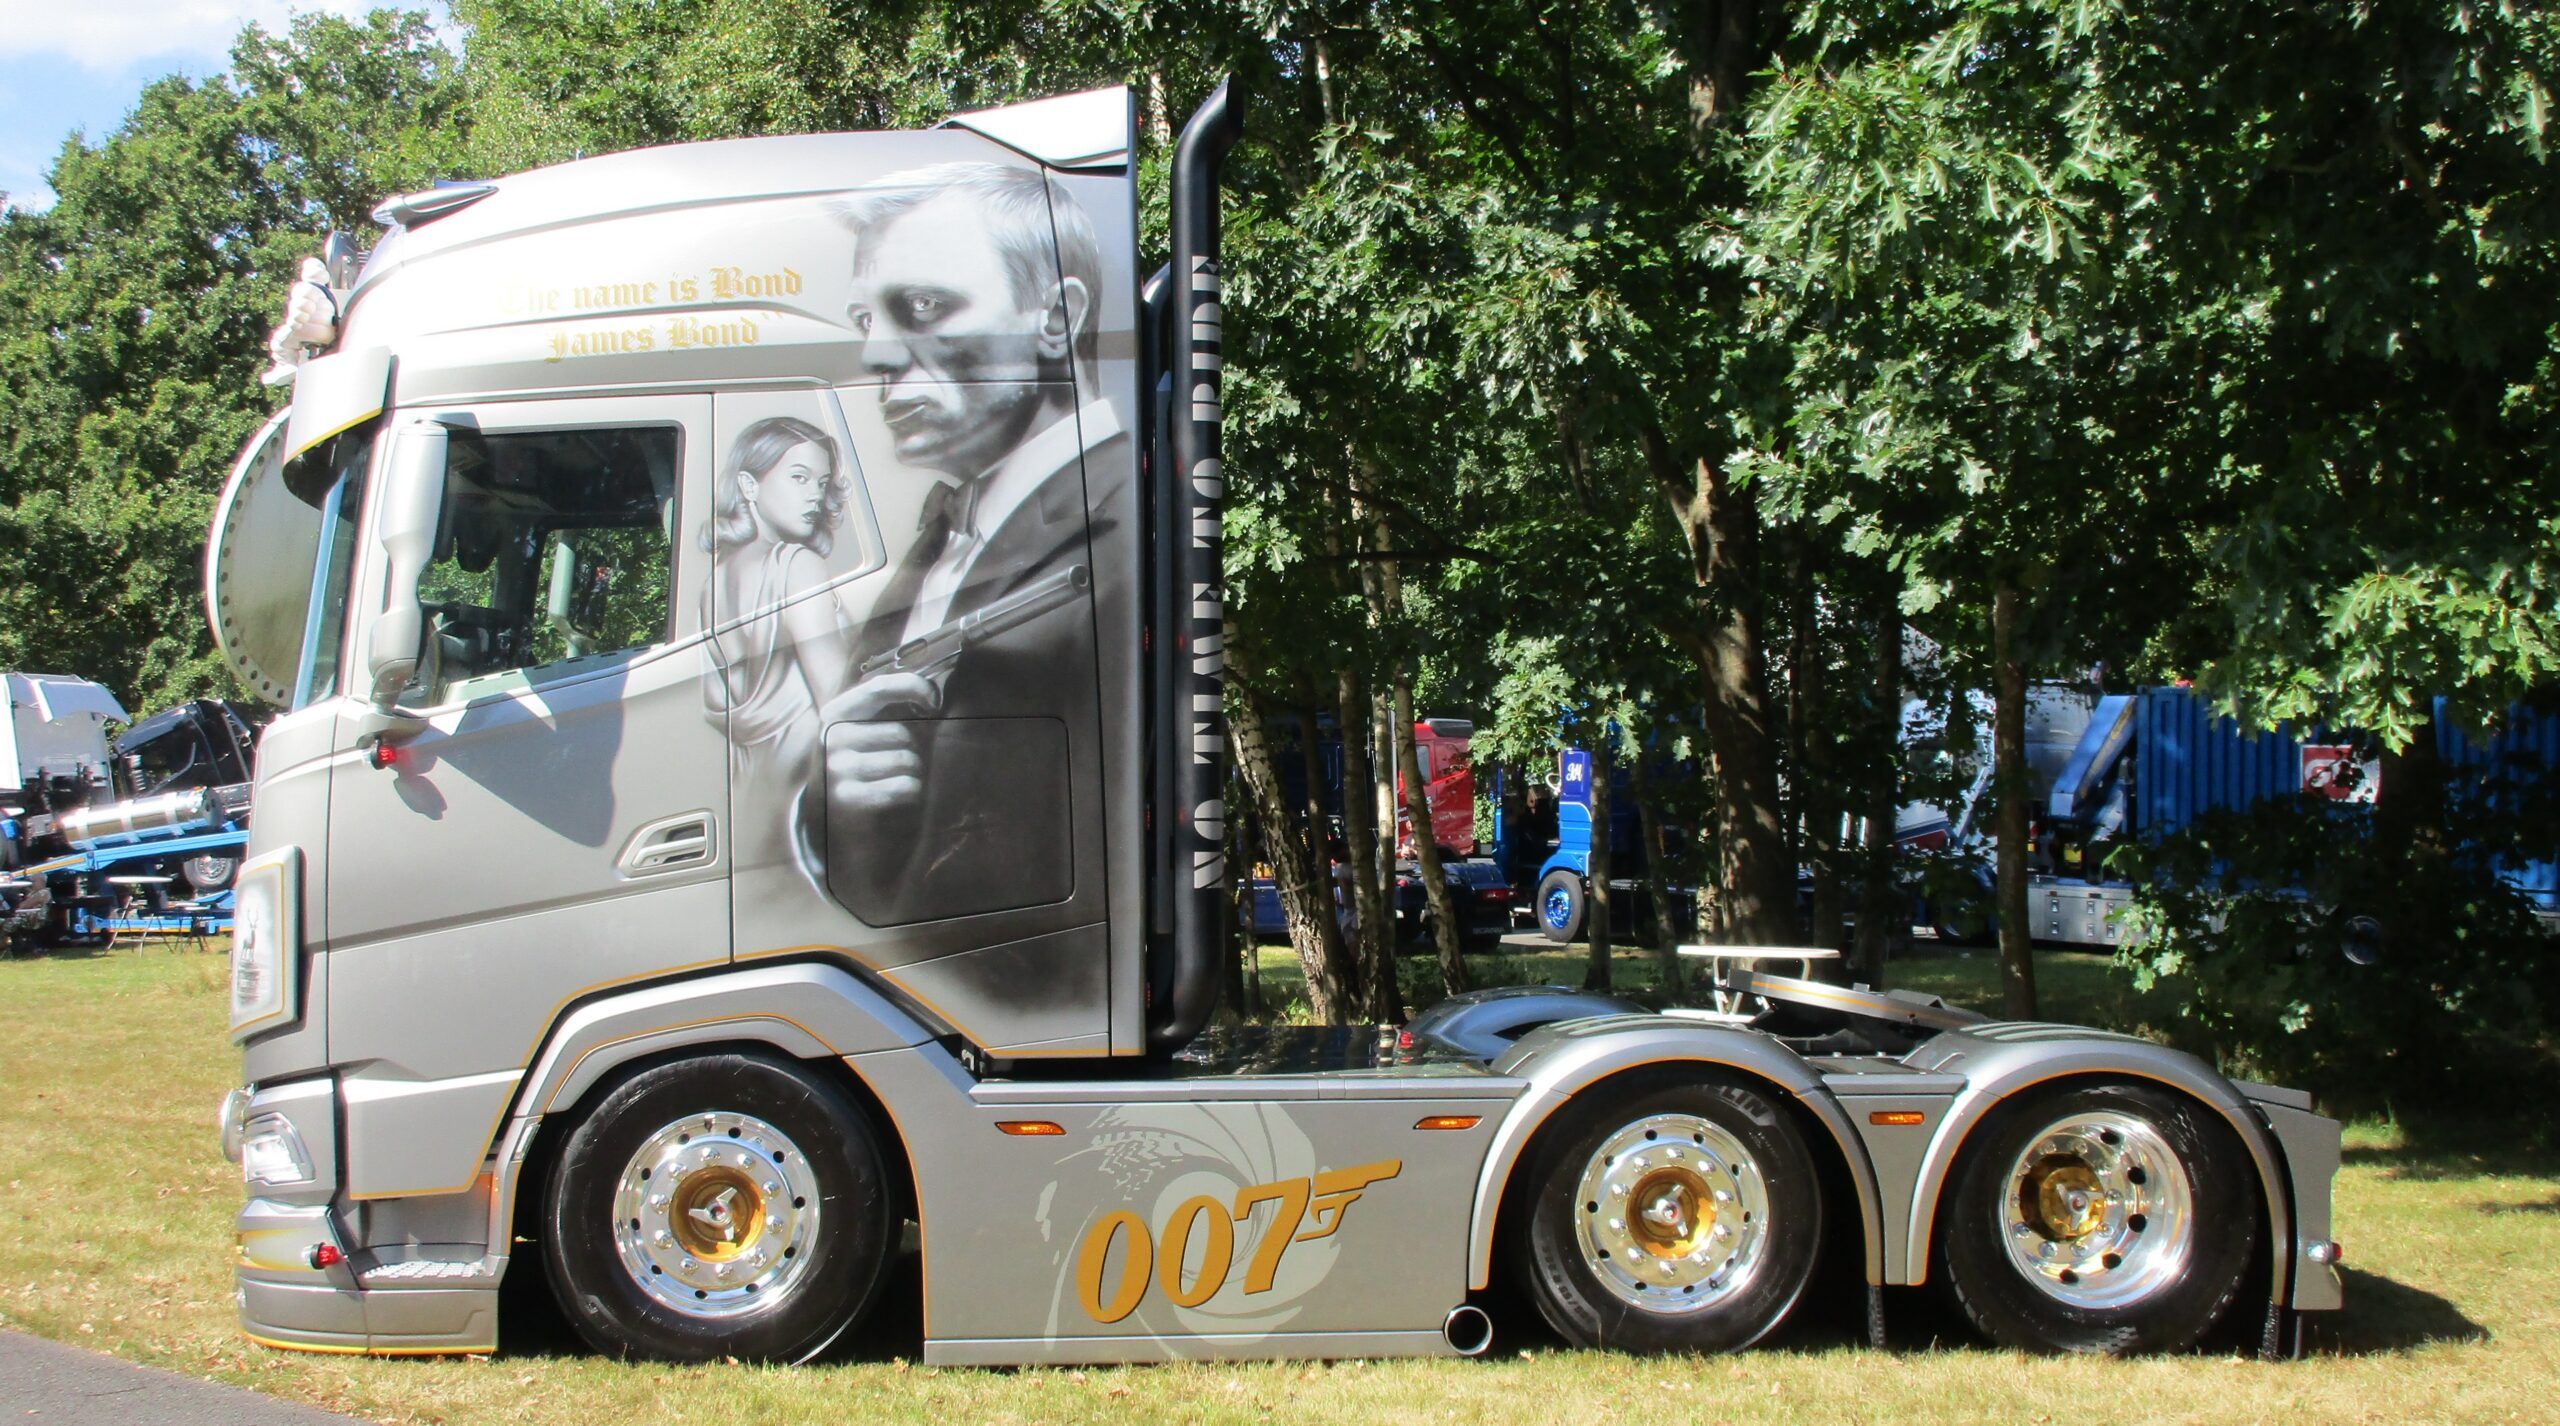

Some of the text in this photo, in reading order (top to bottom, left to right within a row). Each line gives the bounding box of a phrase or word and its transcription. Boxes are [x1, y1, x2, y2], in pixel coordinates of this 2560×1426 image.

[573, 281, 657, 309] name
[668, 272, 698, 303] is
[710, 266, 802, 300] Bond
[544, 323, 655, 362] James
[1191, 253, 1225, 889] NO TIME TO RIDE
[1076, 1177, 1311, 1324] 007
